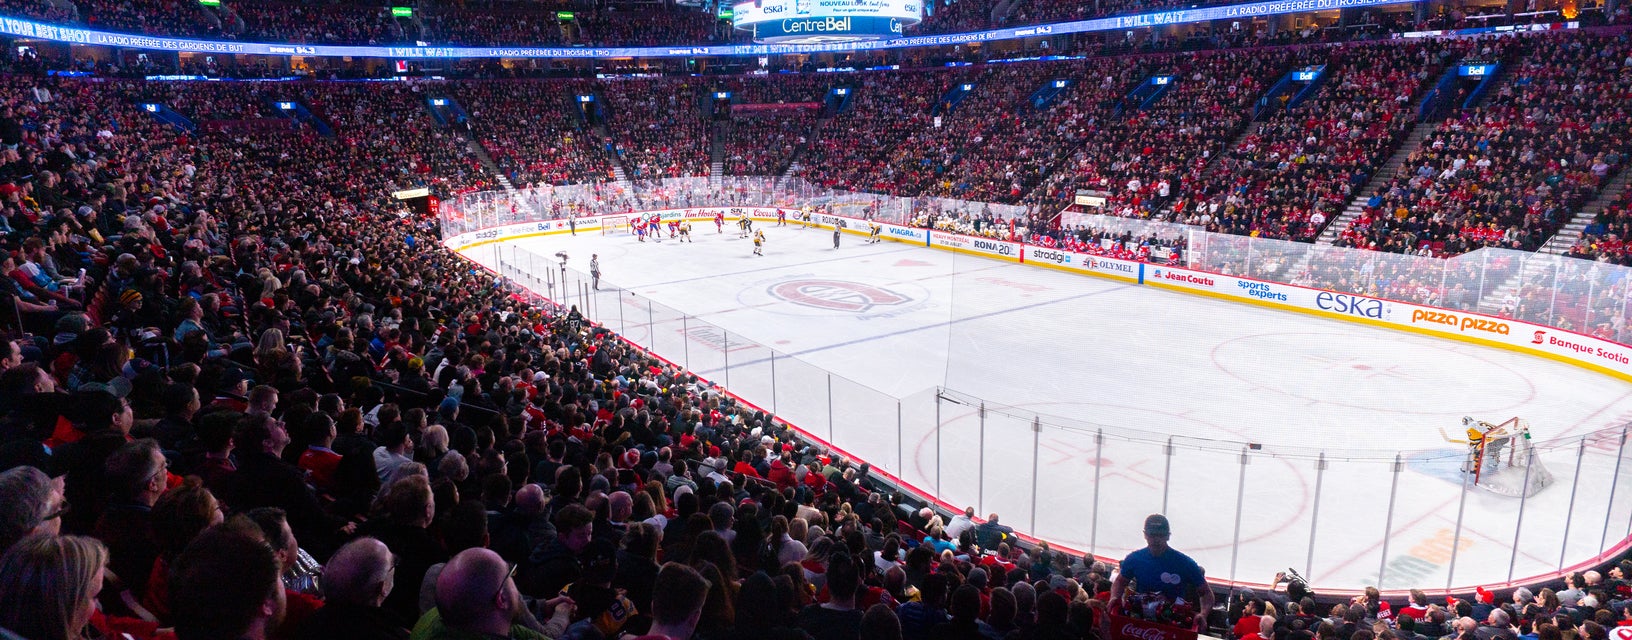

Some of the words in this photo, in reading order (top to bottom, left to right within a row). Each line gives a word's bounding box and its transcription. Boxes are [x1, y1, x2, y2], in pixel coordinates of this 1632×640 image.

[764, 5, 782, 14] eska
[1227, 8, 1237, 16] LA
[1240, 5, 1266, 15] RADIO
[1318, 0, 1331, 8] DU
[1124, 15, 1150, 27] WILL
[1154, 11, 1184, 25] WAIT
[5, 18, 34, 36] YOUR
[35, 24, 58, 40] BEST
[60, 28, 91, 43] SHOT
[98, 35, 107, 43] LA
[108, 36, 129, 45] RADIO
[162, 41, 177, 49] DES
[180, 41, 214, 51] GARDIENS
[229, 44, 243, 52] BUT
[1300, 72, 1313, 80] Bell
[1469, 66, 1485, 75] Bell
[684, 209, 697, 218] Tim
[698, 209, 719, 218] Horto
[538, 223, 550, 231] Bell
[974, 240, 998, 251] RONA
[999, 244, 1009, 255] 20
[1033, 249, 1064, 264] stradigi
[1099, 261, 1133, 273] OLYMEL
[1165, 271, 1186, 282] Jean
[1187, 275, 1214, 286] Coutu
[1238, 280, 1270, 291] sports
[1249, 288, 1287, 301] experts
[1316, 291, 1383, 319] eska
[1412, 309, 1458, 326] pizza
[1460, 317, 1510, 336] pizza
[1549, 336, 1594, 354] Banque
[1596, 347, 1630, 364] Scotia
